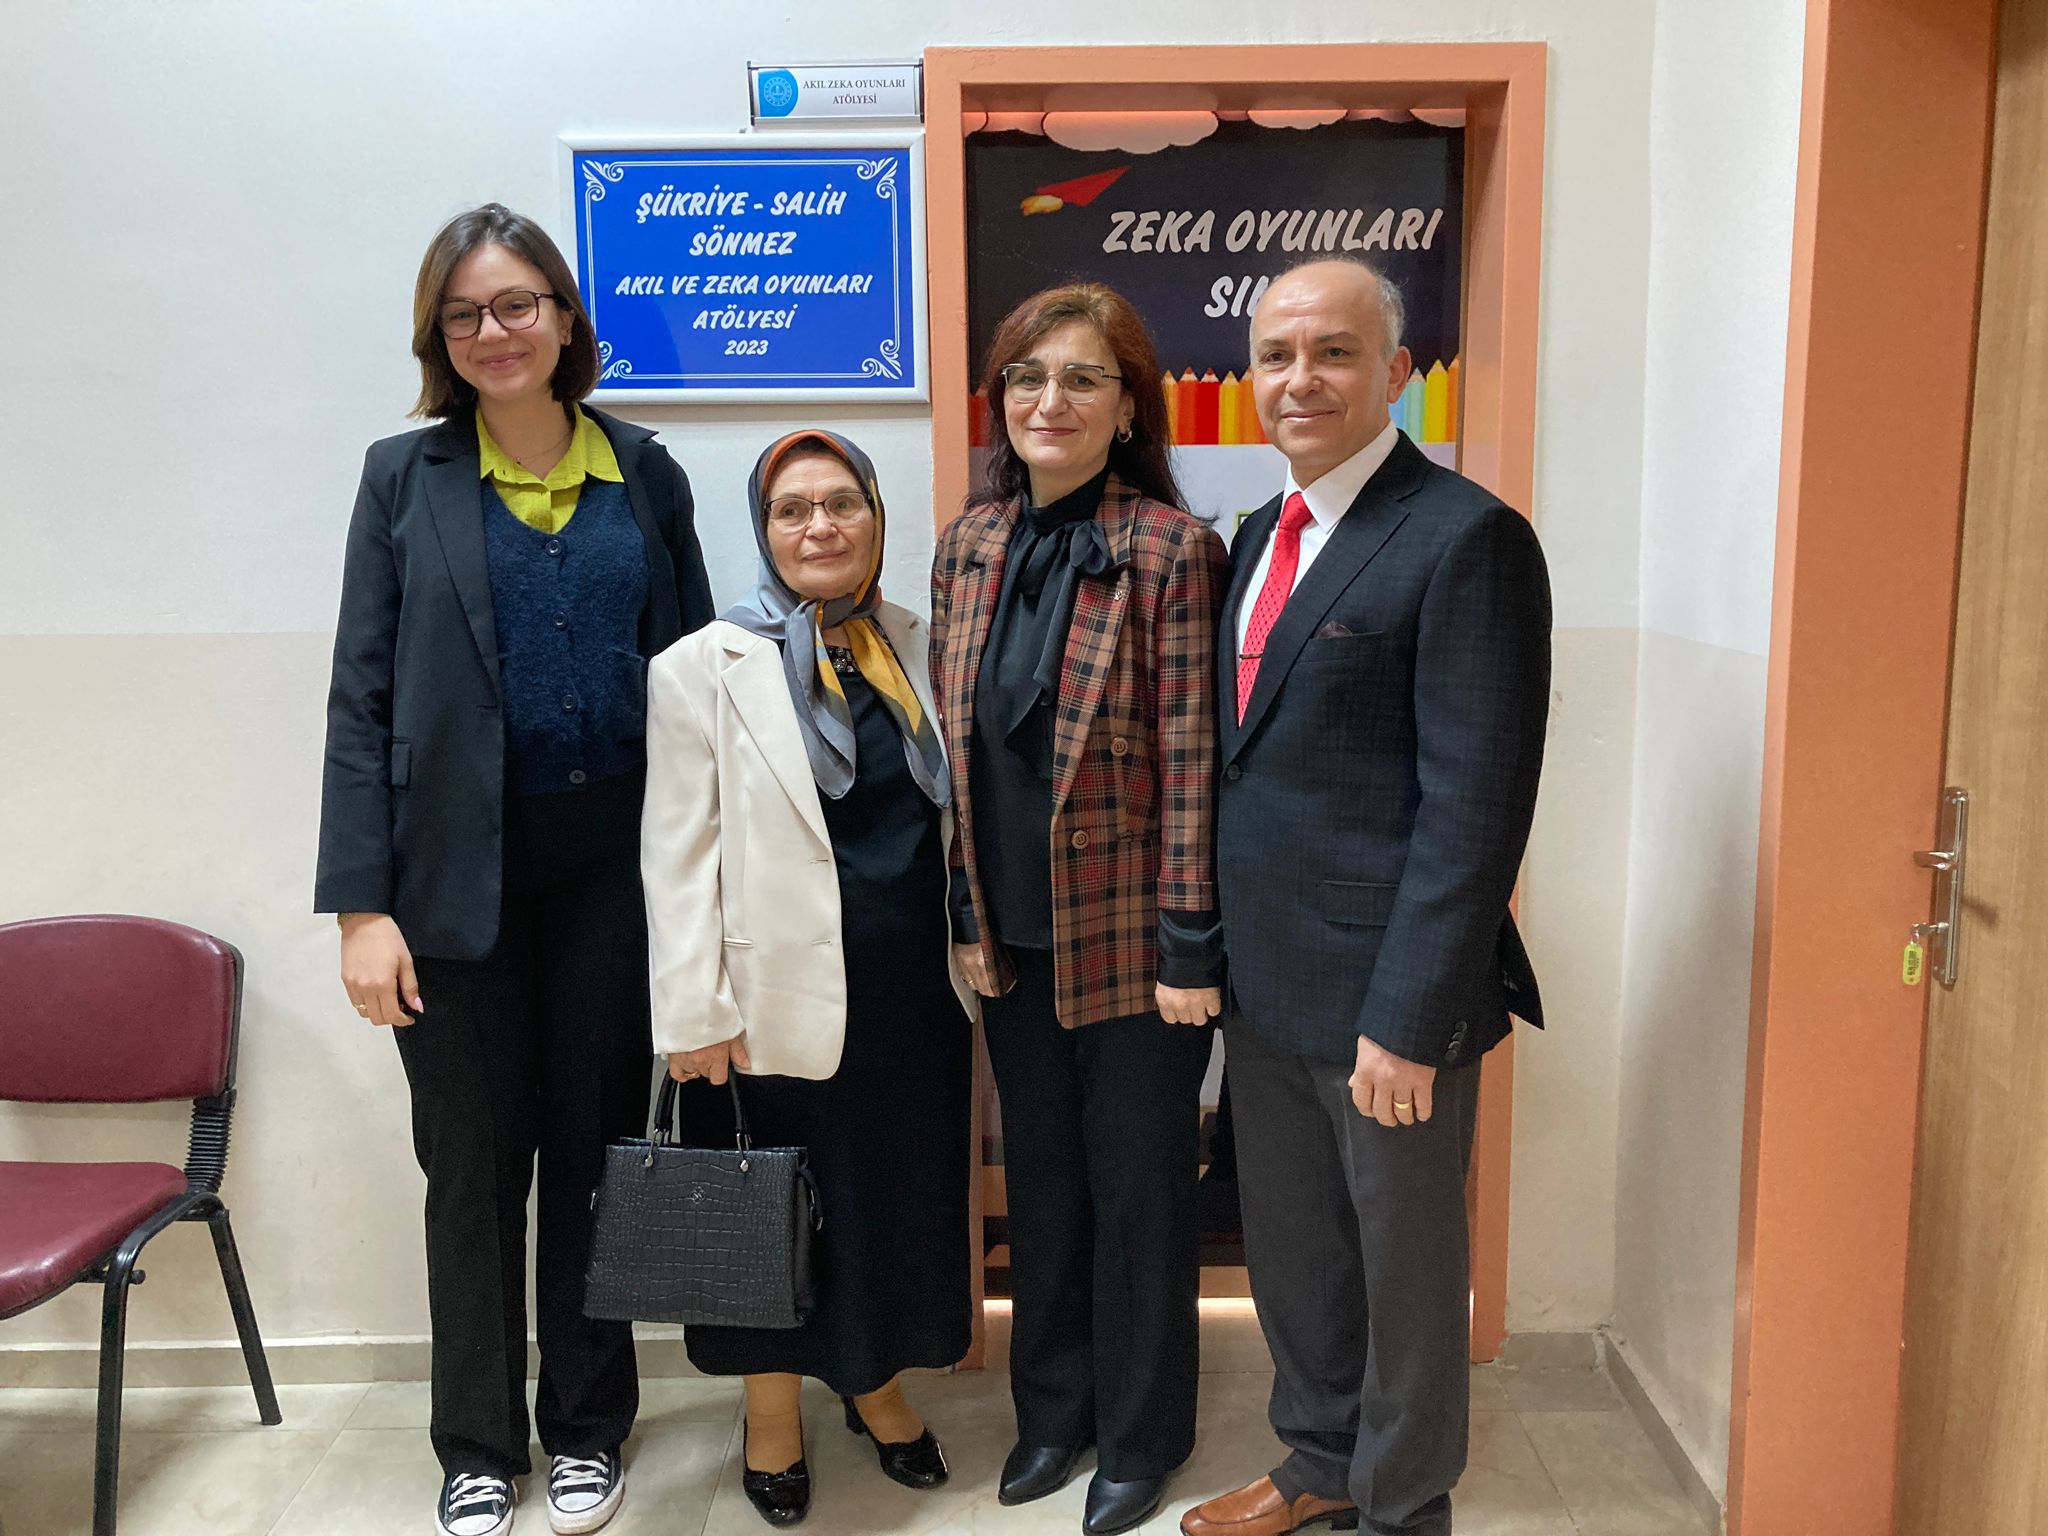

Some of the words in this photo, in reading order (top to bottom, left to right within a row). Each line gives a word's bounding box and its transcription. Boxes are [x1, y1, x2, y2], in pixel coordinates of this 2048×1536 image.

[803, 80, 826, 89] AKIL
[828, 80, 853, 89] ZEKA
[855, 79, 905, 88] OYUNLARI
[832, 94, 877, 104] ATÖLYESİ
[635, 184, 749, 224] ŞÜKRİYE
[770, 183, 848, 216] SALİH
[688, 224, 798, 257] SÖNMEZ
[1102, 209, 1216, 254] ZEKA
[1225, 207, 1444, 253] OYUNLARI
[615, 275, 665, 296] AKIL
[671, 275, 700, 295] VE
[702, 274, 760, 295] ZEKA
[764, 274, 873, 294] OYUNLARI
[692, 303, 799, 330] ATÖLYESİ
[724, 339, 769, 356] 2023
